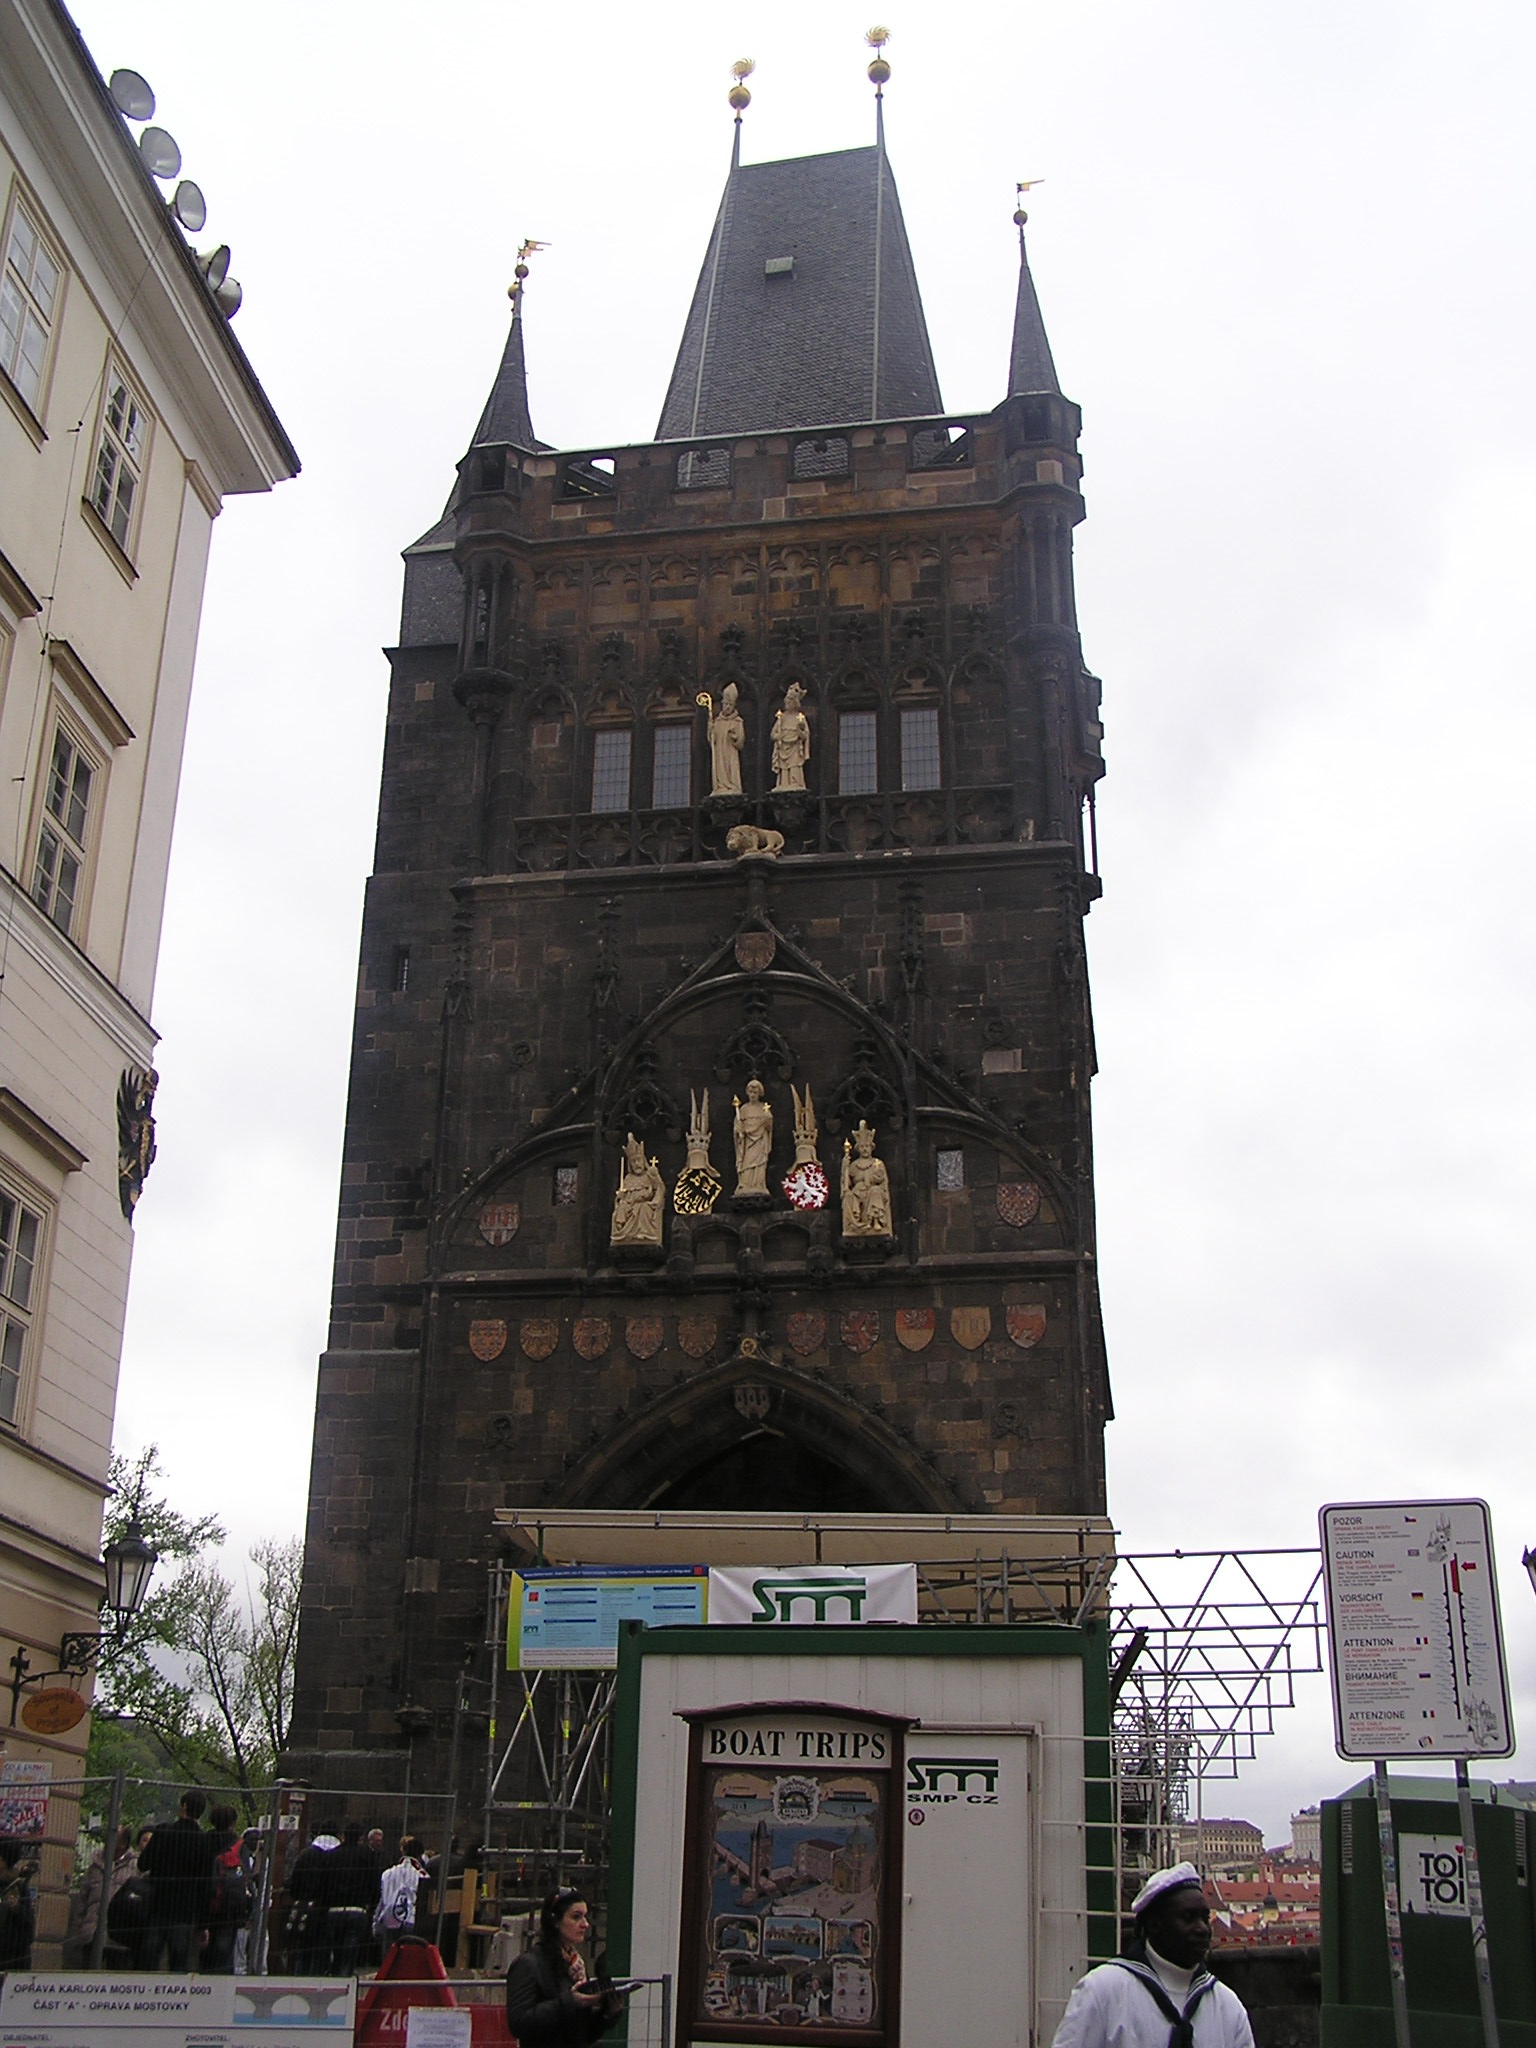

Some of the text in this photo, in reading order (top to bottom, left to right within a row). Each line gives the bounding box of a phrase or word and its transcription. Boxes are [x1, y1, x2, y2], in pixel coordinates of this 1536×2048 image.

[1333, 1516, 1362, 1526] POZOR
[1335, 1550, 1375, 1560] CAUTION
[1339, 1592, 1384, 1603] VORSICHT
[1344, 1637, 1394, 1648] ATTENTION
[1345, 1671, 1398, 1681] ВНИМАНИЕ
[1349, 1710, 1406, 1720] ATTENZIONE
[710, 1729, 885, 1760] BOAT TRIPS
[907, 1794, 1000, 1805] SMP CZ
[1419, 1850, 1464, 1879] TOI
[1420, 1877, 1465, 1905] TOI
[14, 1984, 56, 1994] OPRAVA
[58, 1984, 107, 1995] KARLOVA
[110, 1984, 145, 1995] MOSTU
[154, 1985, 188, 1995] ETAPA
[89, 2001, 131, 2011] OPRAVA
[134, 2001, 190, 2012] MOSTOVKY
